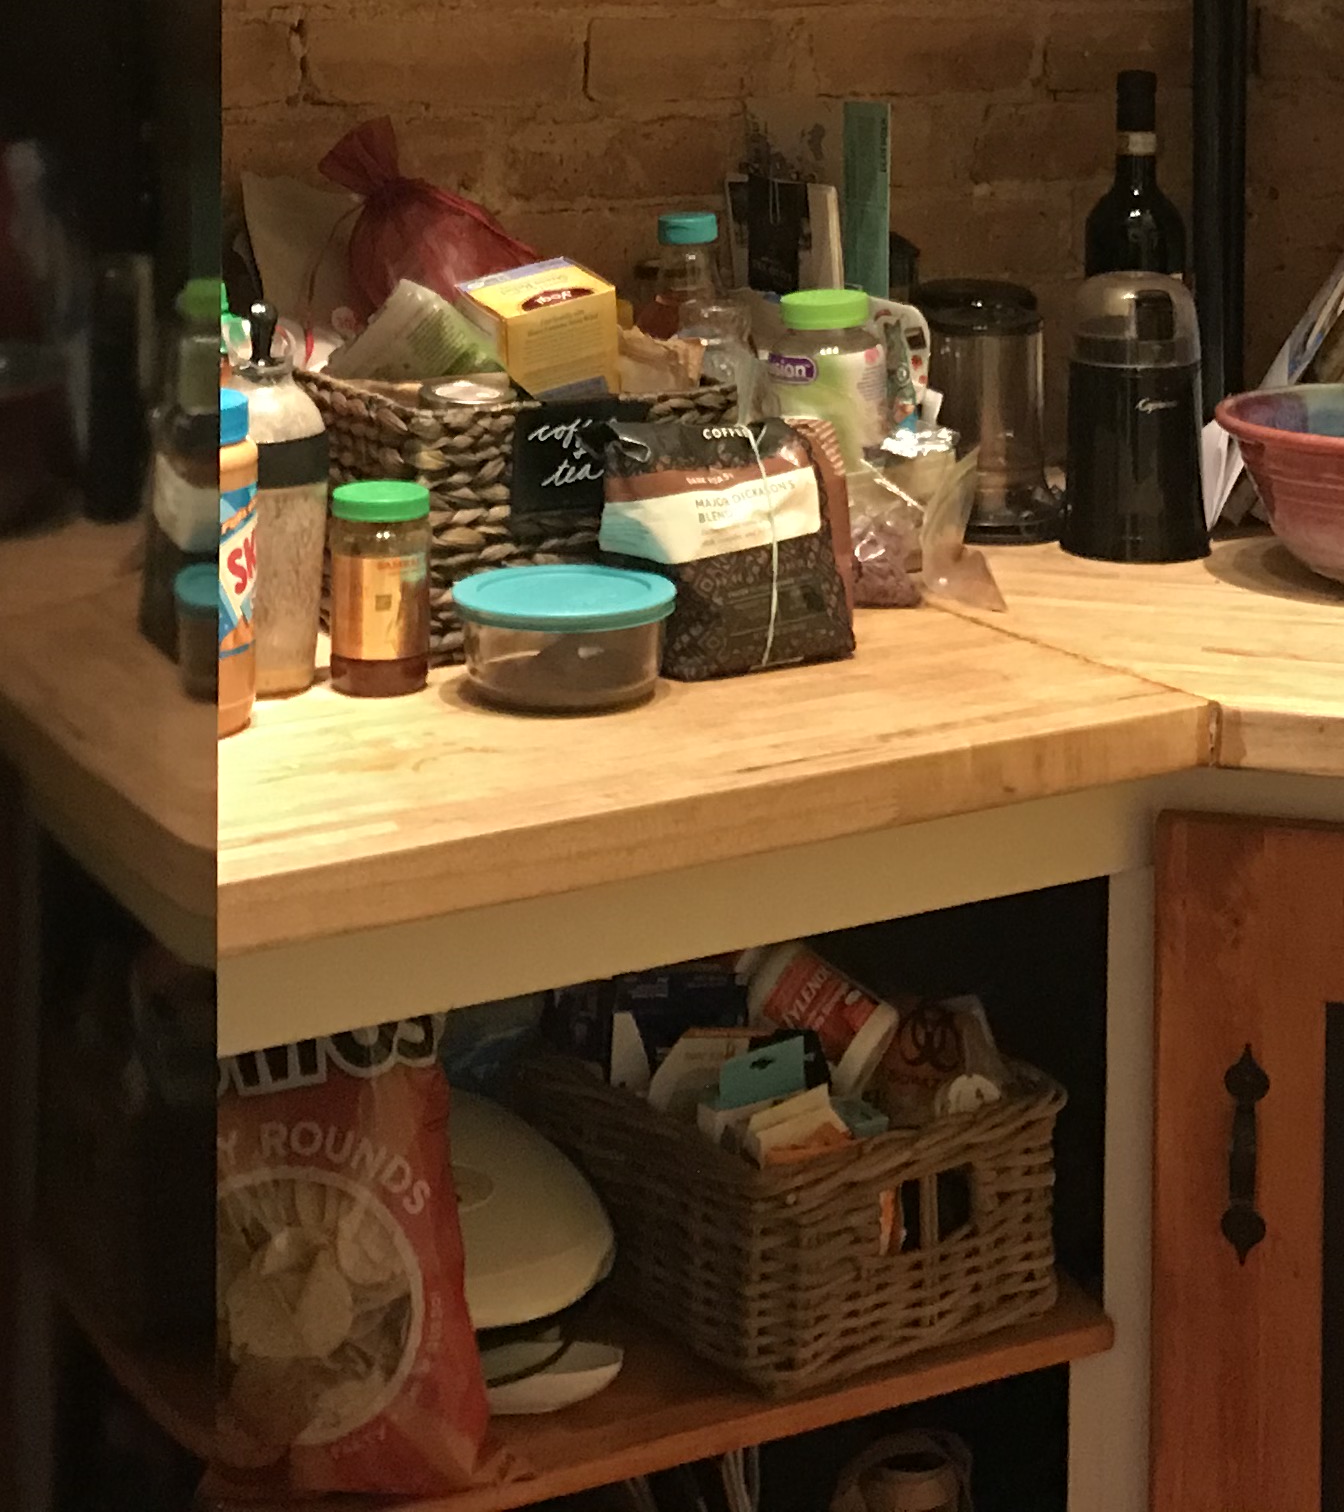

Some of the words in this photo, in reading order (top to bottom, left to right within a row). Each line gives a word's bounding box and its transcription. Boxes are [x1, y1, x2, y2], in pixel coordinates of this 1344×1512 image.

[541, 461, 605, 488] tea
[695, 494, 732, 510] MAJOR
[259, 1119, 432, 1216] ROUNDS
